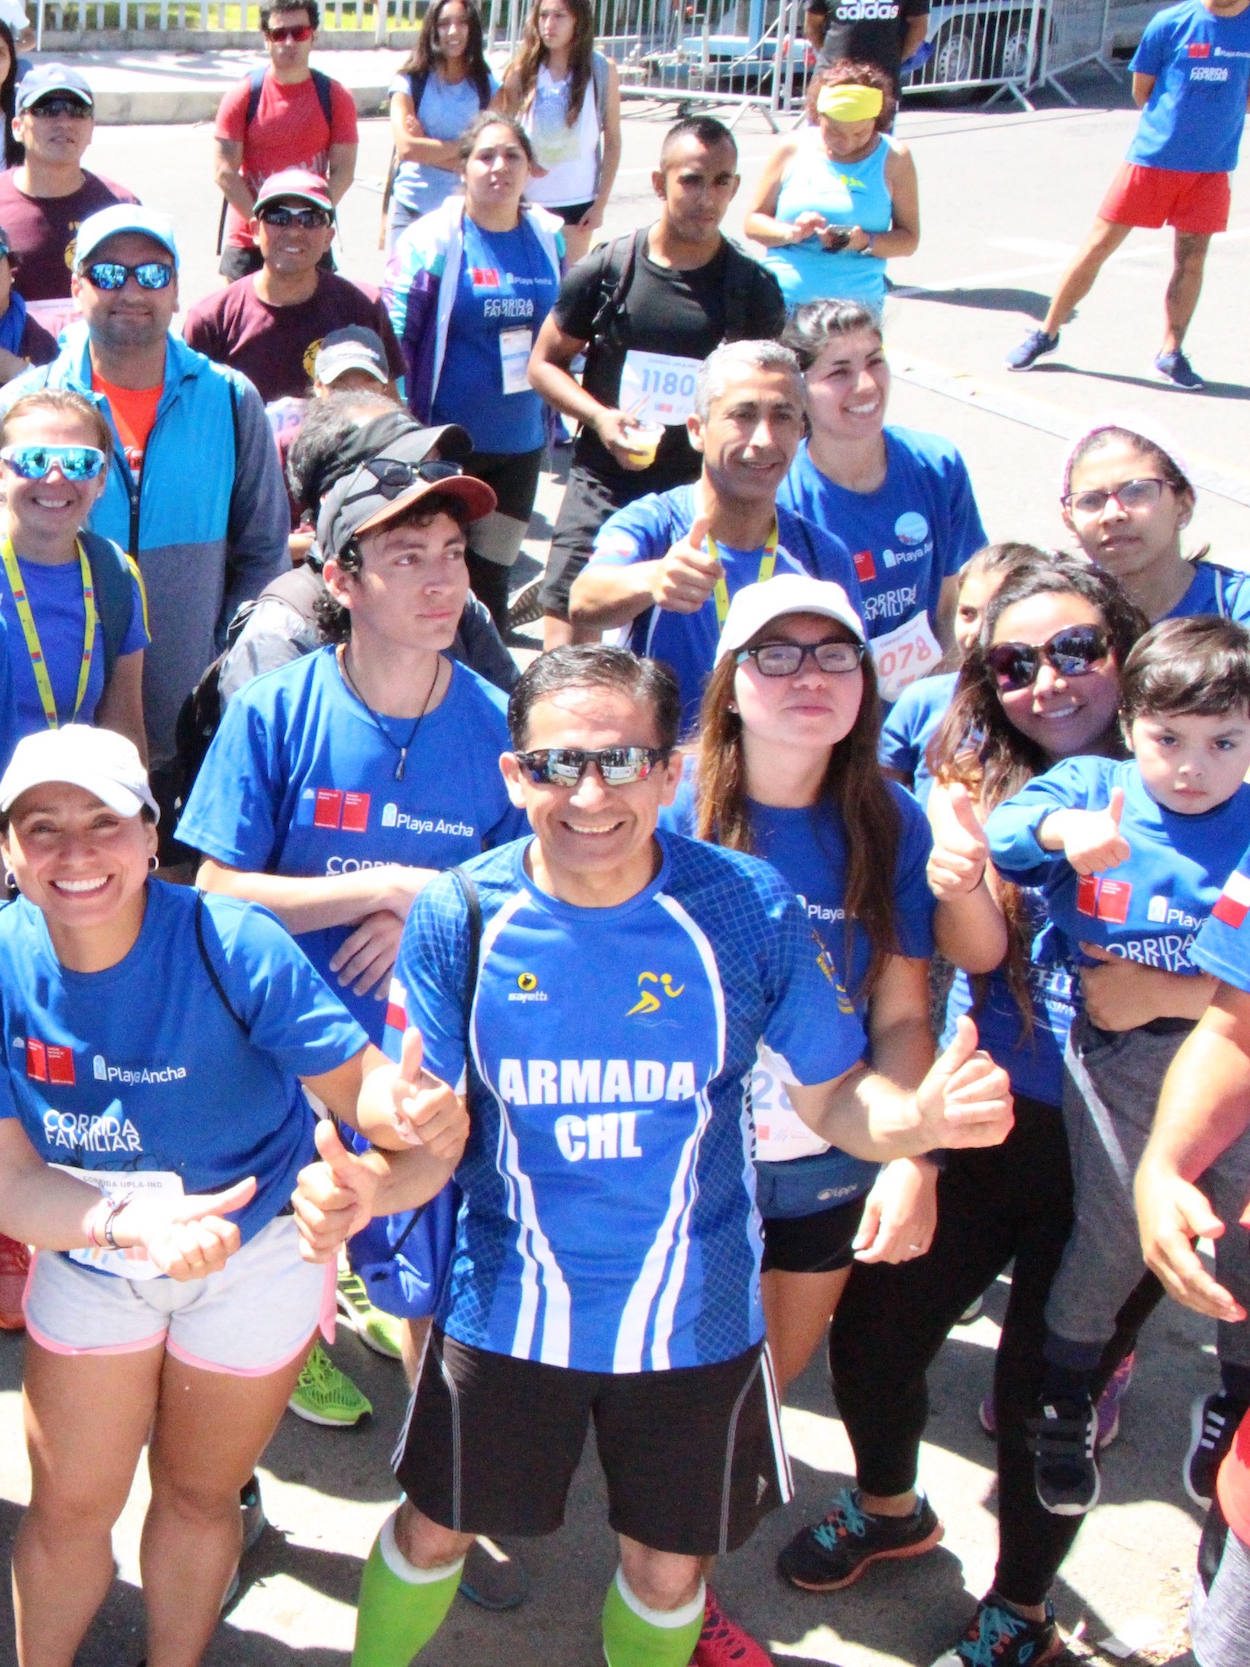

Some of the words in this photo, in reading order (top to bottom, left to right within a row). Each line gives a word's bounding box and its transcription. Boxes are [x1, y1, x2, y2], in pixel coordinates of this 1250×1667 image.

[836, 2, 899, 19] adidas
[642, 369, 695, 397] 1180
[396, 813, 433, 835] Playa
[435, 819, 475, 837] Ancha
[808, 904, 845, 923] Playa
[141, 1067, 187, 1084] Ancha
[498, 1058, 697, 1106] ARMADA
[43, 1109, 139, 1137] CORRIDA
[44, 1127, 144, 1152] FAMILIAR
[554, 1111, 643, 1163] CHL
